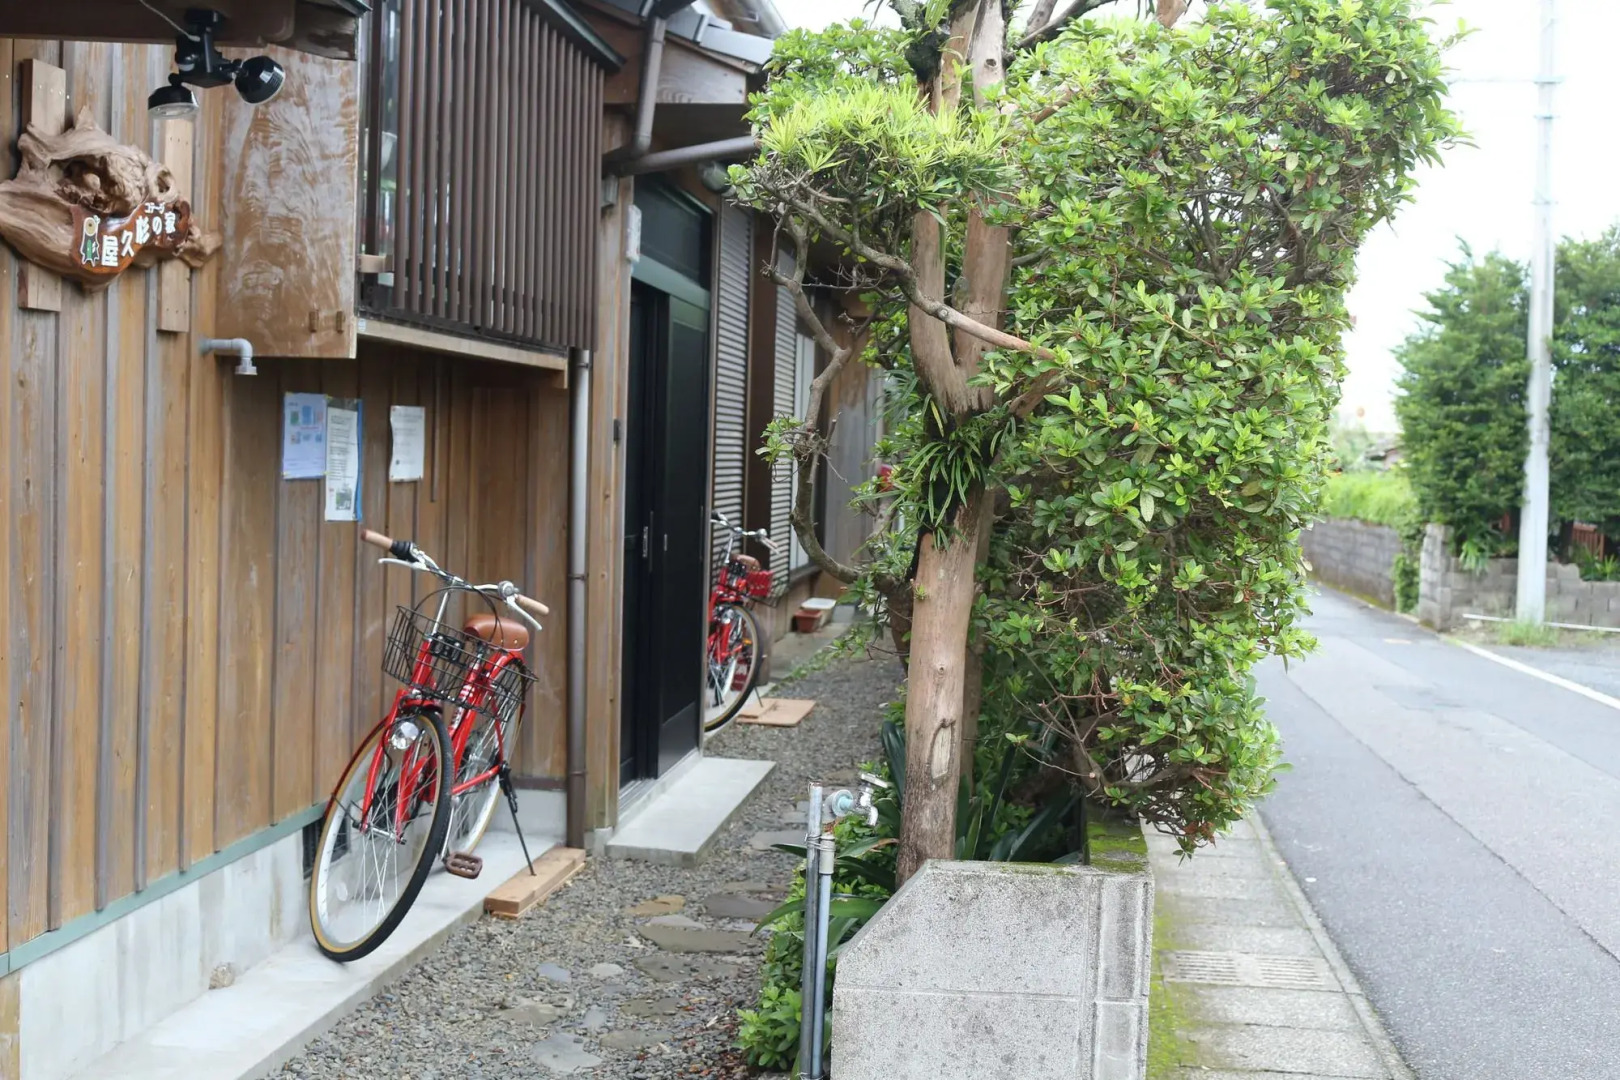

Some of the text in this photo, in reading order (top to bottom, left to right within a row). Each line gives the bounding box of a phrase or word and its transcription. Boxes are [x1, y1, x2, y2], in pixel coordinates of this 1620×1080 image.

[101, 211, 176, 267] 屋久杉の家
